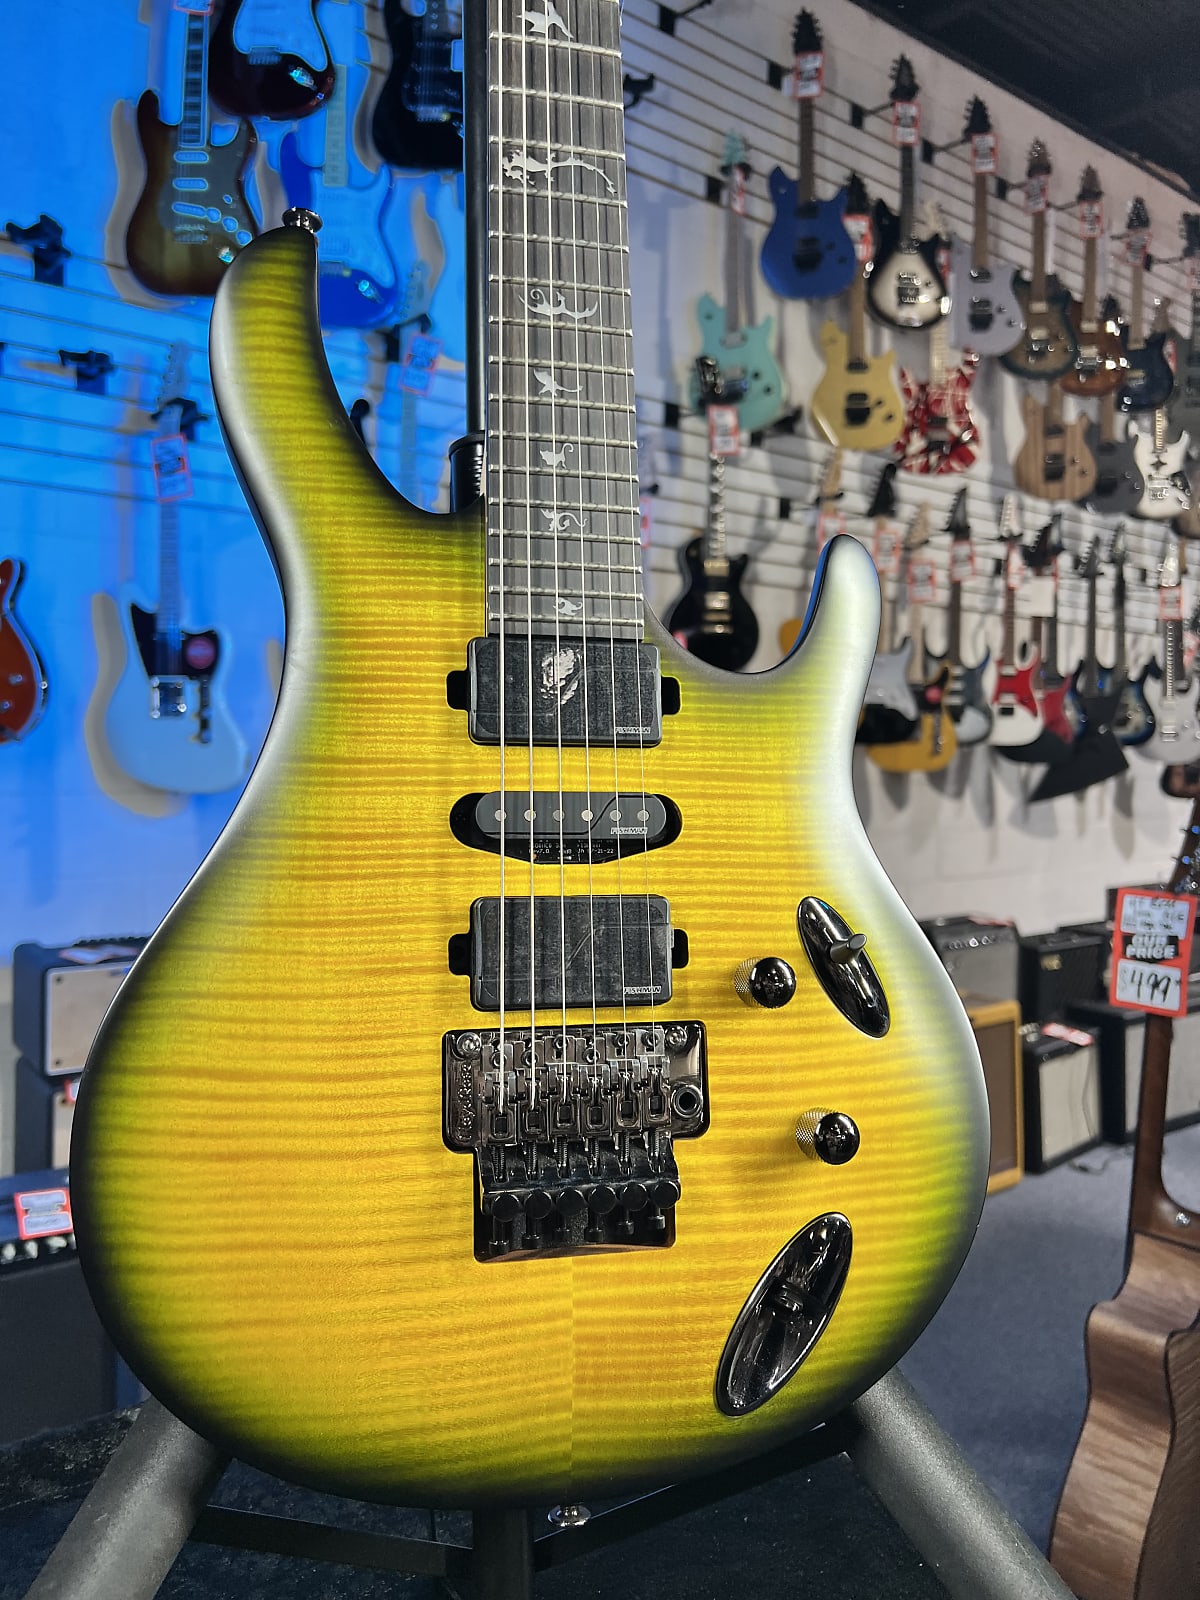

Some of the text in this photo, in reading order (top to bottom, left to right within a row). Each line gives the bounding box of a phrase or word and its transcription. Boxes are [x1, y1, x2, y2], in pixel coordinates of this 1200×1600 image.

[610, 827, 648, 835] FISHMAN
[1125, 944, 1176, 960] PRICE
[623, 985, 662, 995] FISHMAN
